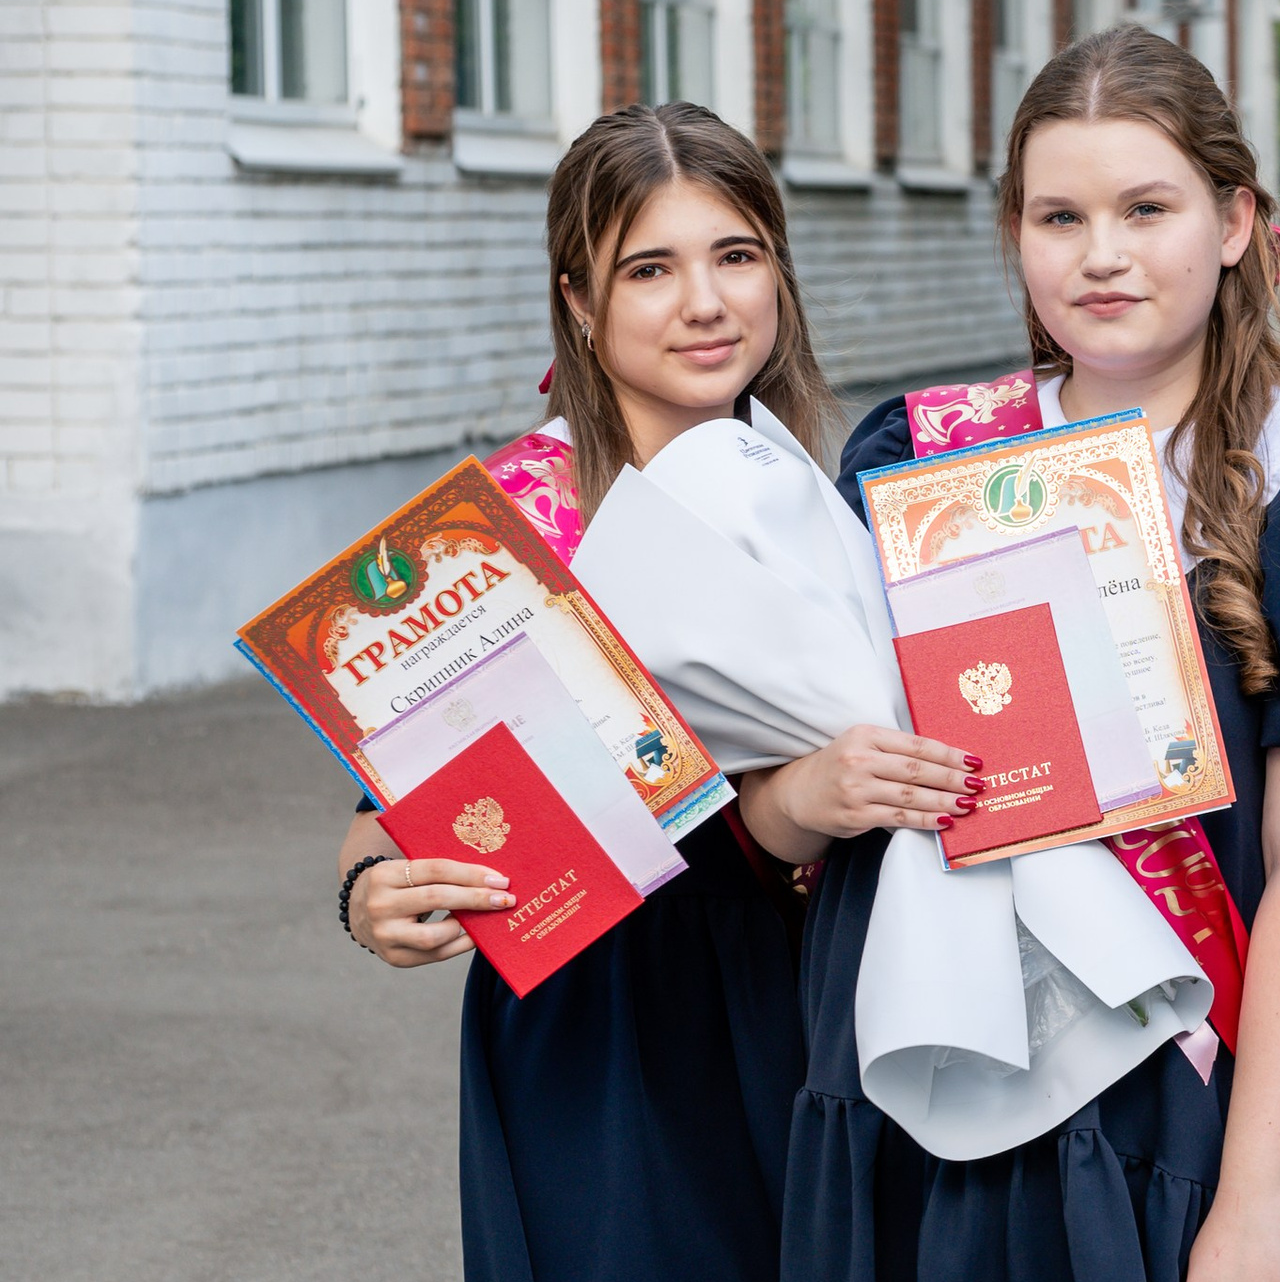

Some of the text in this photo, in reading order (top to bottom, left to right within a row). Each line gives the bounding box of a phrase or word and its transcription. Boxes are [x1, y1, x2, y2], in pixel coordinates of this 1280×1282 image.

[1098, 576, 1142, 599] лёна
[341, 560, 512, 687] ГРАМОТА
[401, 604, 488, 671] награждается
[390, 604, 535, 714] Скрипник Алина
[980, 761, 1051, 789] ТТЕСТАТ
[984, 791, 1027, 806] ОСНОВНОМ
[1026, 784, 1054, 796] ОБЩЕМ
[988, 795, 1042, 813] ОБРАЗОВАНИИ
[507, 869, 578, 932] АТТЕСТАТ
[520, 889, 588, 943] ОБ ОСНОВНОМ ОБЩЕМ
[536, 903, 582, 940] ОБРАЗОВАНИИ
